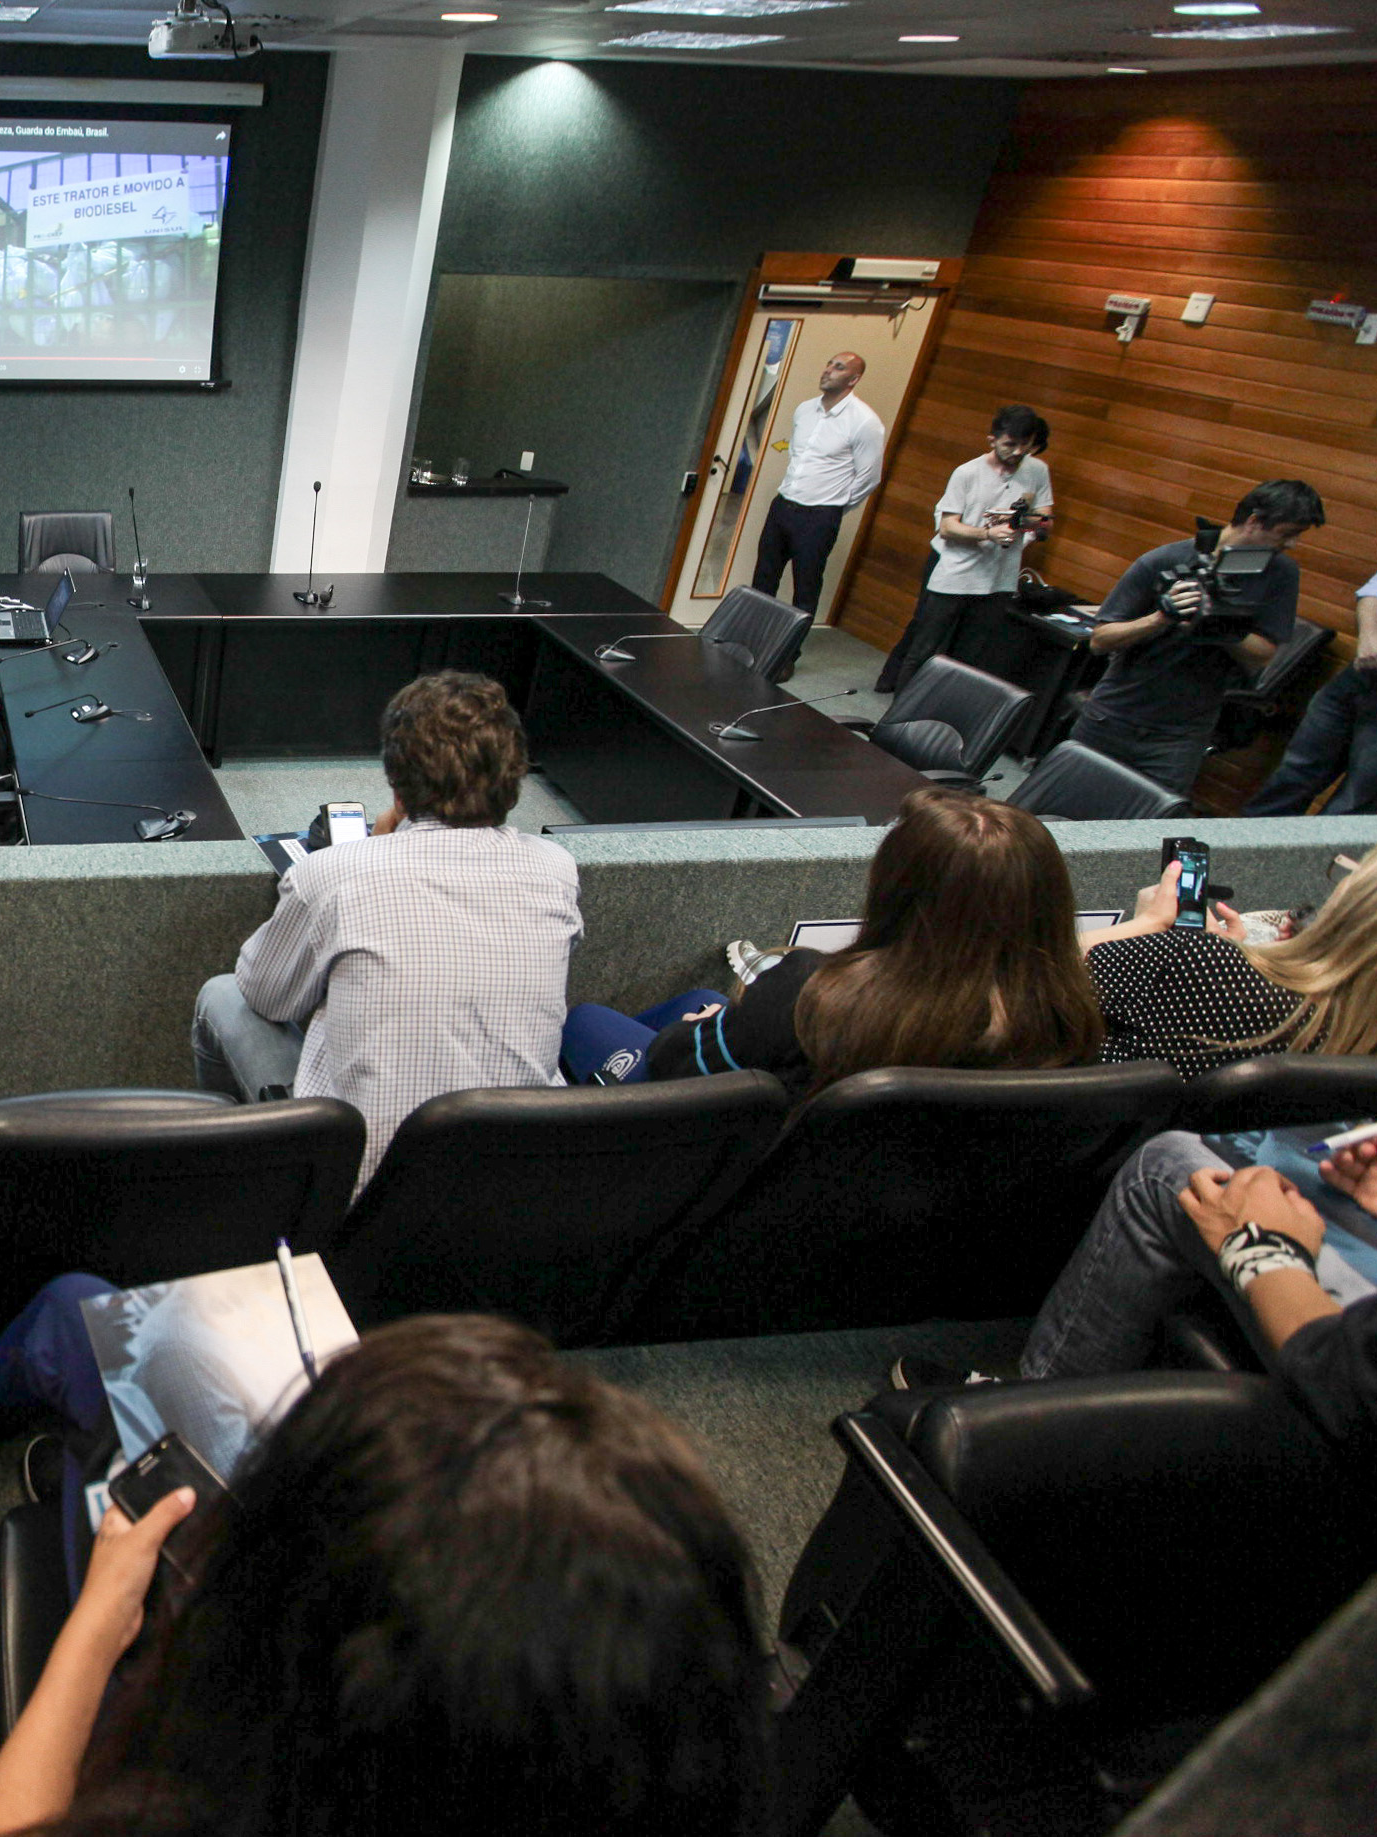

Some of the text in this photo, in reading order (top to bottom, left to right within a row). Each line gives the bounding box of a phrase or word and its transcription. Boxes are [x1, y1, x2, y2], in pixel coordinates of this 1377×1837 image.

[15, 126, 43, 136] Guarda
[44, 126, 55, 136] do
[56, 126, 85, 137] Embaú,
[86, 127, 109, 137] Brasil.
[32, 176, 185, 207] ESTE TRATOR É MOVIDO A
[74, 201, 137, 219] BIODIESEL
